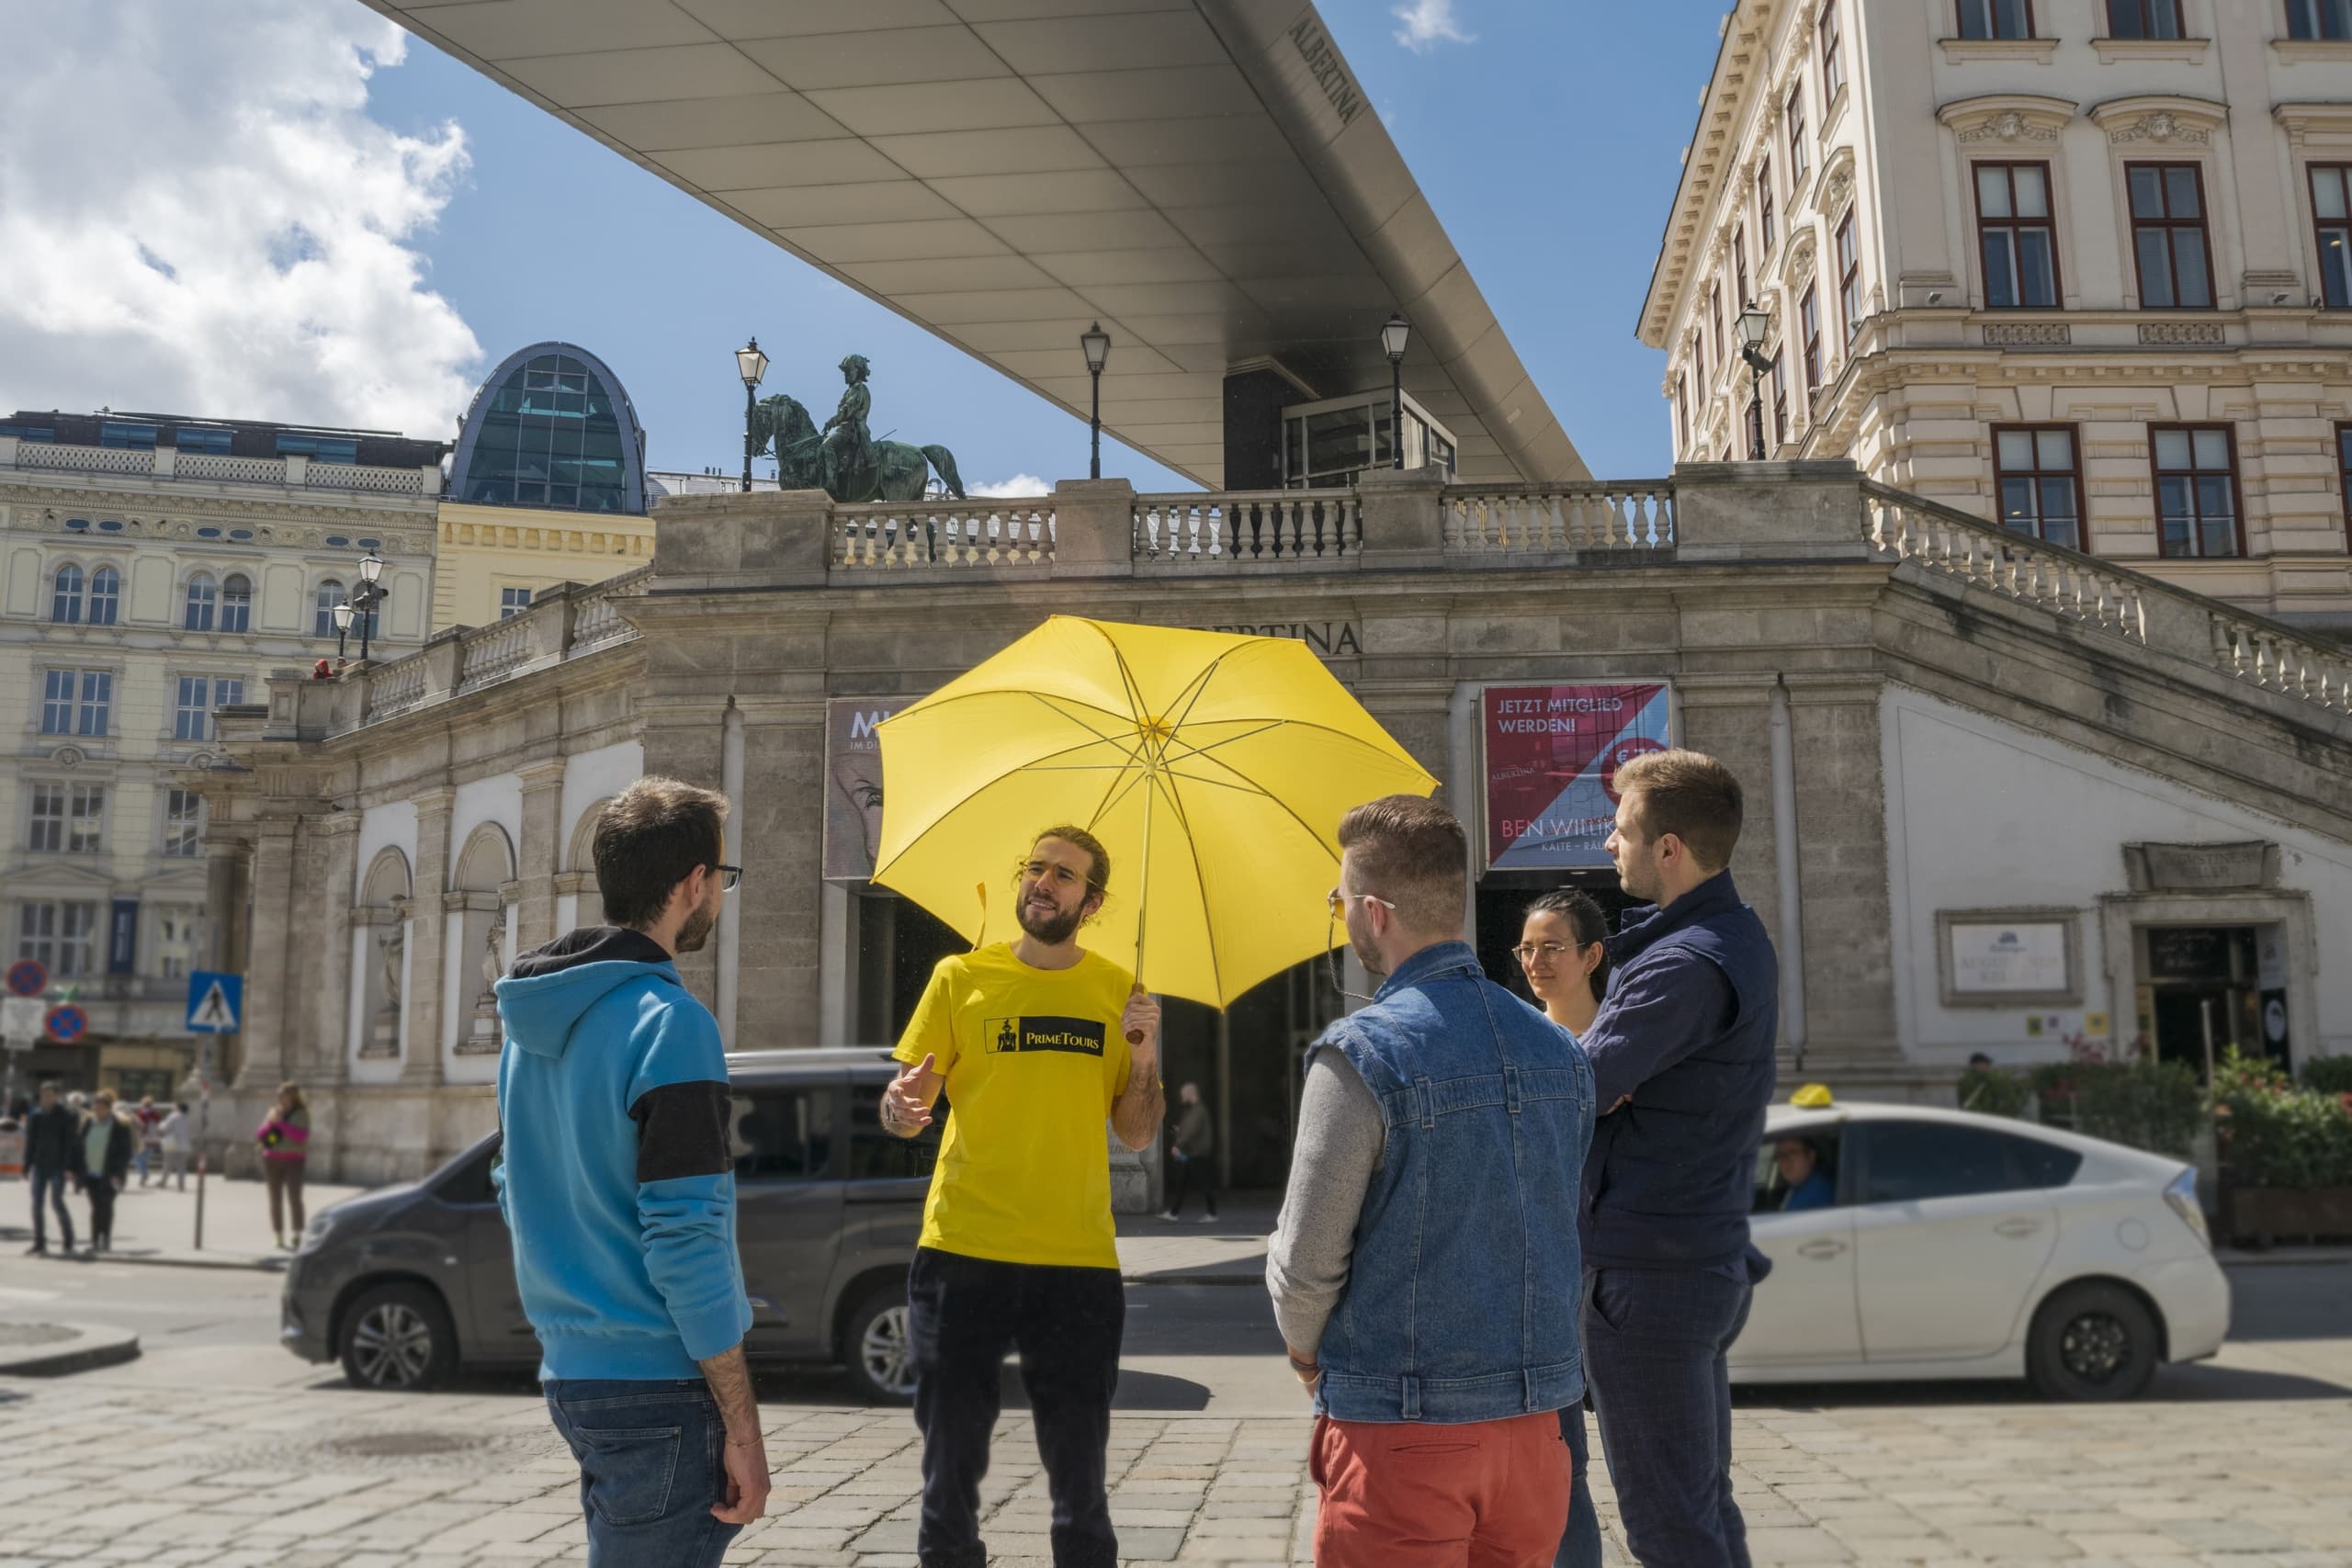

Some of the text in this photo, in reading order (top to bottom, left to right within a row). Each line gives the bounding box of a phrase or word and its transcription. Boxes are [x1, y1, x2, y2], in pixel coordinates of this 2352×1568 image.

[1288, 17, 1361, 126] ALBERTINA
[1498, 697, 1623, 714] JETZT MITGLIED
[1498, 718, 1576, 733] WERDEN!
[1501, 819, 1544, 838] BEN
